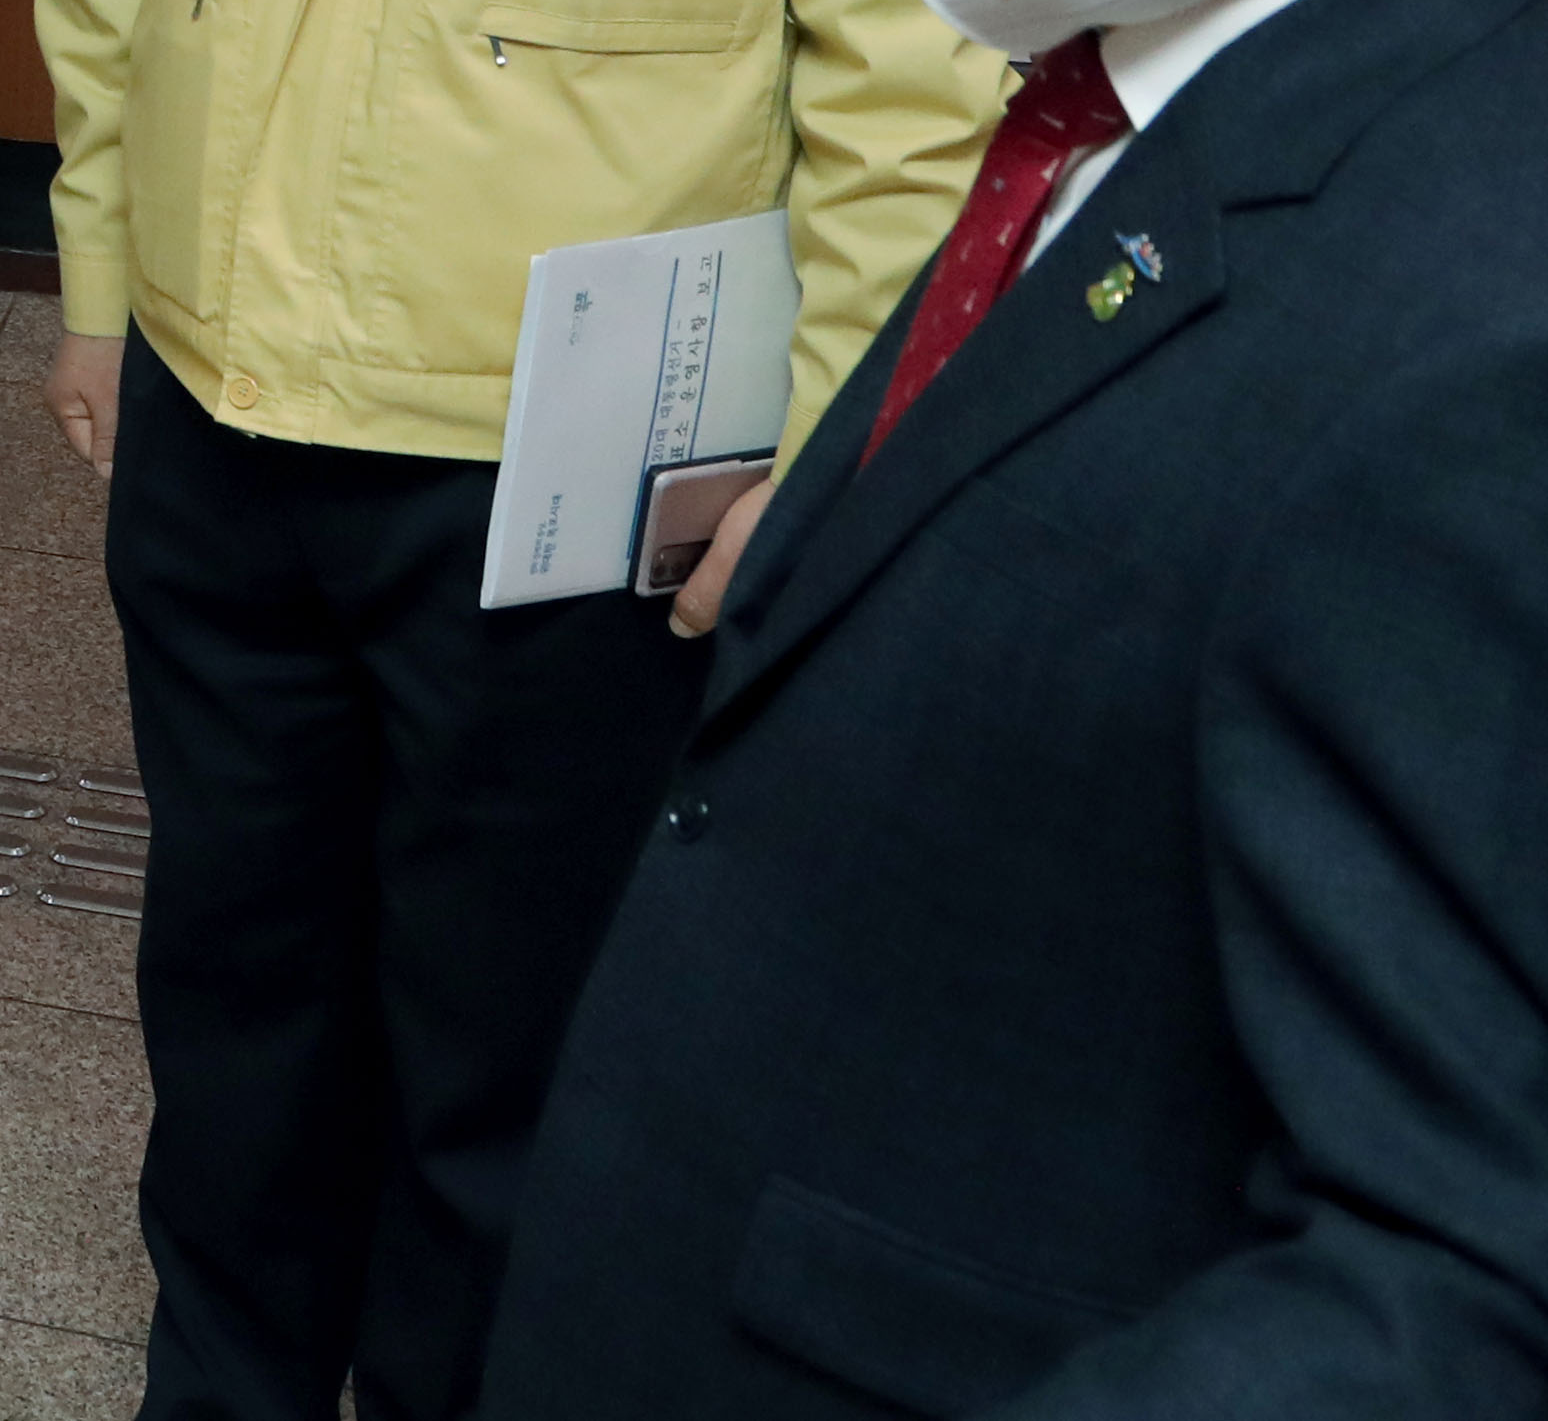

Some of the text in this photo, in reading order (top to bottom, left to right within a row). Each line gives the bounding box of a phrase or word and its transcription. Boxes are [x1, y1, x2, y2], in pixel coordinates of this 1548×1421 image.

[658, 340, 684, 420] 대통령선거
[680, 315, 708, 404] 운영사항
[697, 253, 714, 296] 보고
